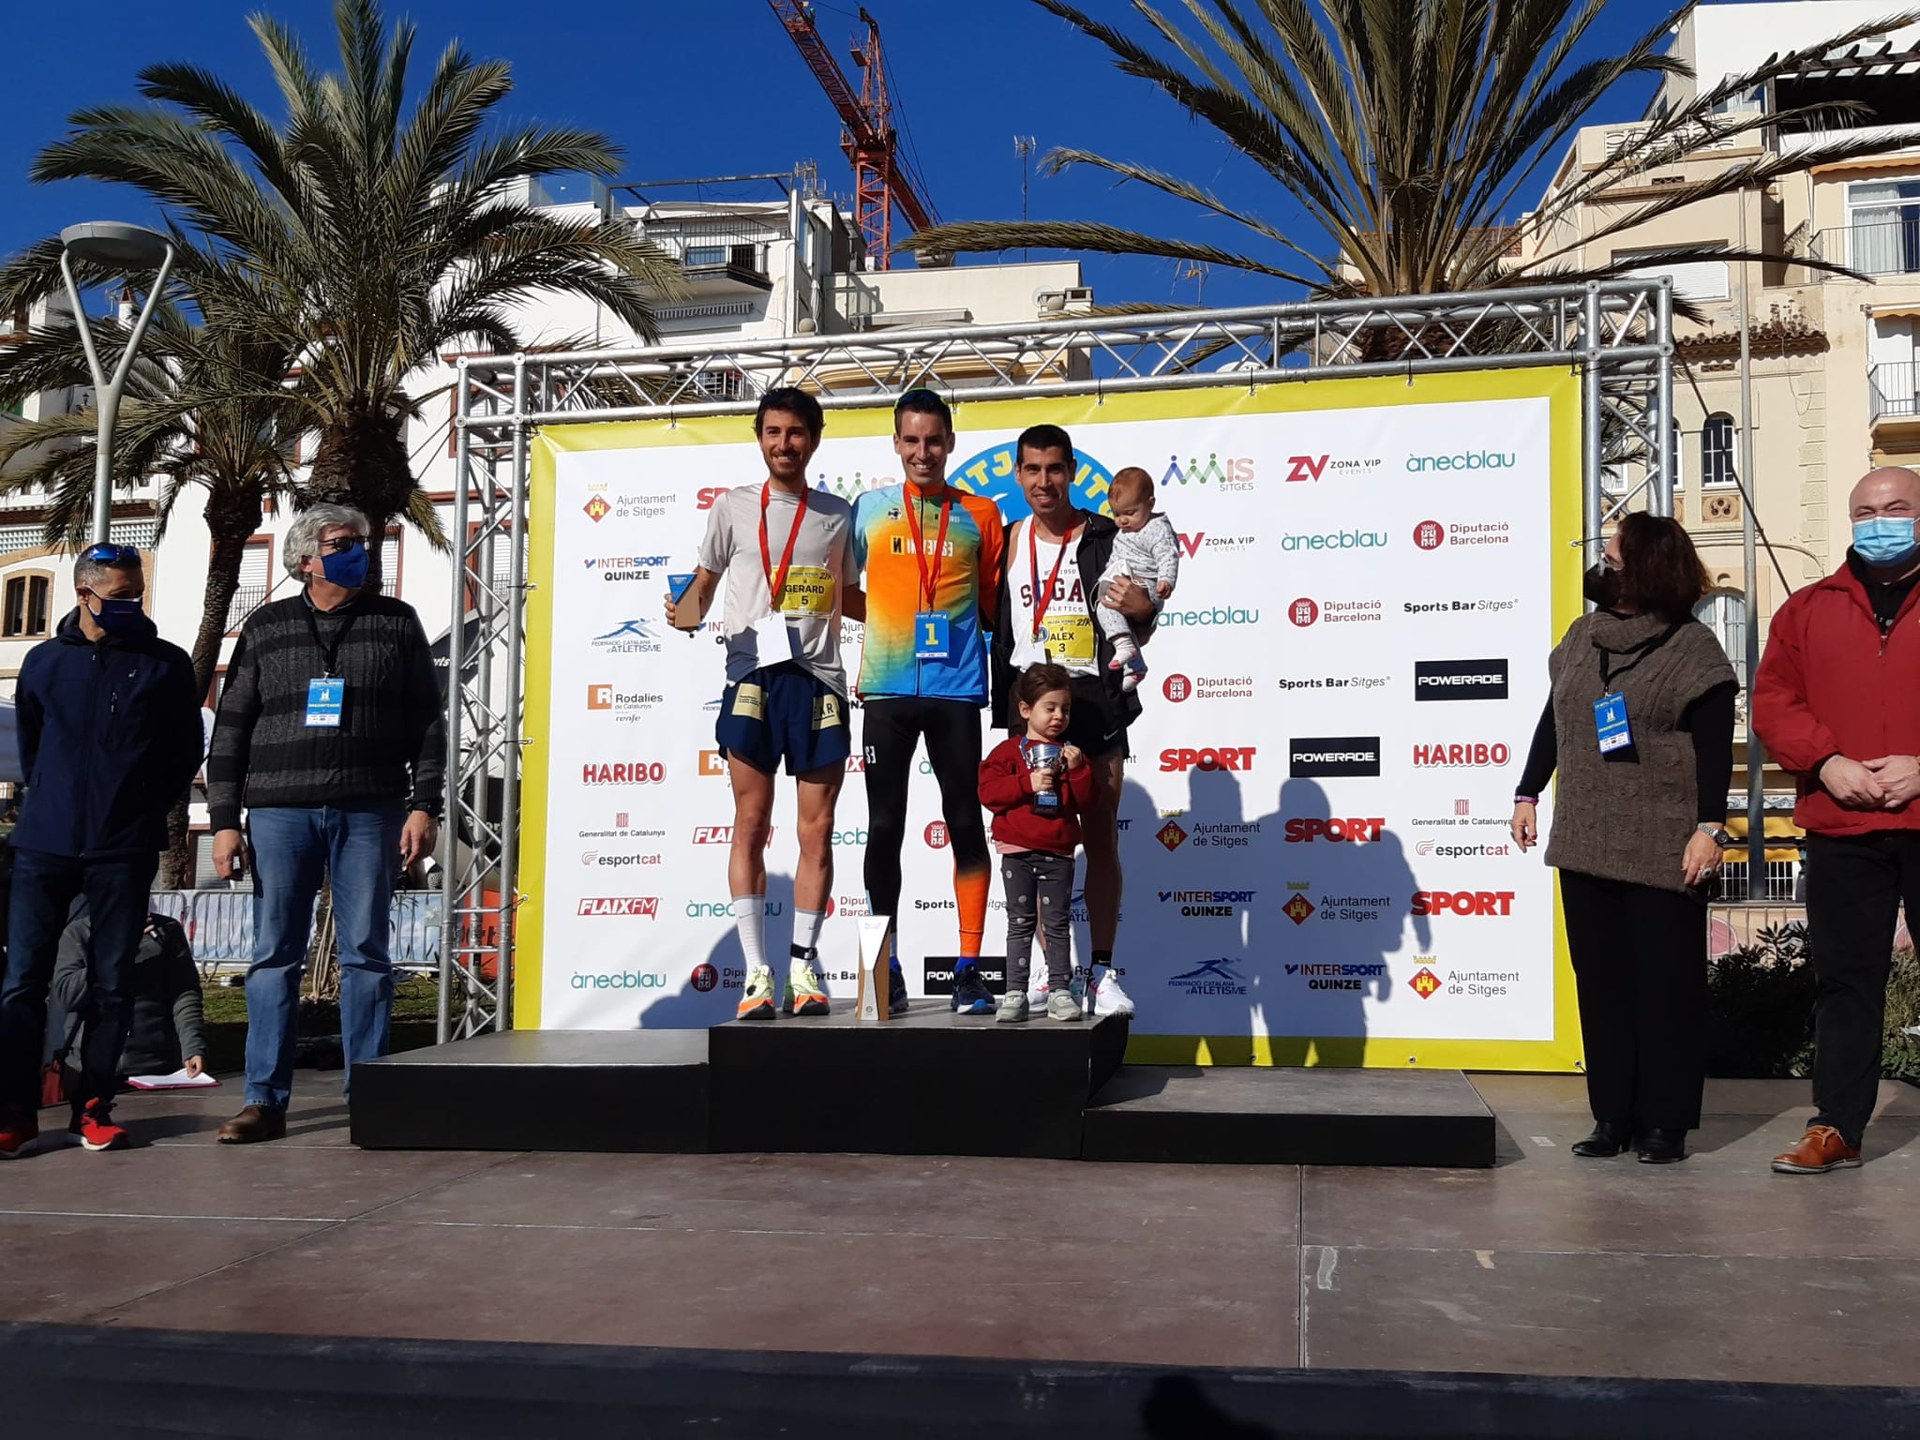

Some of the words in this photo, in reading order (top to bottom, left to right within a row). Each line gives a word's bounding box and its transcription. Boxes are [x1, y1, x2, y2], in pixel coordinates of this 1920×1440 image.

[1330, 460, 1360, 469] ZONA
[1364, 459, 1381, 467] VIP
[1406, 450, 1515, 472] ànecblau
[1219, 483, 1254, 492] SITGES
[616, 493, 676, 506] Ajuntament
[616, 507, 629, 518] de
[631, 506, 665, 518] Sitges
[1450, 522, 1509, 536] Diputació
[1205, 538, 1234, 546] ZONA
[1238, 537, 1255, 545] VIP
[1282, 530, 1387, 551] ànecblau
[1450, 533, 1509, 545] Barcelona
[598, 556, 671, 569] INTERSPORT
[604, 571, 650, 581] QUINZE
[785, 584, 825, 594] GERARD
[801, 595, 809, 605] 5
[1324, 600, 1381, 613] Diputació
[1404, 602, 1448, 614] Sports
[1451, 600, 1476, 611] Bar
[1324, 611, 1381, 623] Barcelona
[925, 623, 938, 645] 1
[1050, 632, 1075, 641] ALEX
[1058, 643, 1066, 653] 3
[1197, 676, 1253, 689] Diputació
[1279, 678, 1322, 690] Sports
[1326, 677, 1349, 688] Bar
[1418, 674, 1504, 686] POWERADE
[615, 693, 663, 703] Rodalies
[1197, 687, 1253, 699] Barcelona
[615, 714, 641, 724] renfe
[1159, 747, 1257, 772] SPORT
[1292, 751, 1377, 763] POWERADE
[1412, 743, 1510, 766] HARIBO
[582, 762, 665, 784] HARIBO
[1411, 818, 1456, 826] Generalitat
[1458, 818, 1469, 826] de
[1471, 818, 1512, 827] Catalunya
[579, 830, 618, 838] Generalitat
[620, 829, 628, 837] de
[630, 829, 665, 838] Catalunya
[1193, 823, 1260, 836] Ajuntament
[1284, 818, 1385, 843] SPORT
[1193, 835, 1206, 846] de
[1209, 834, 1248, 848] Sitges
[1435, 842, 1509, 859] esportcat
[598, 853, 661, 868] esportcat
[1173, 891, 1256, 903] INTERSPORT
[1320, 895, 1390, 909] Ajuntament
[915, 900, 954, 910] Sports
[1410, 892, 1514, 916] SPORT
[1181, 905, 1232, 917] QUINZE
[1320, 909, 1335, 920] de
[1338, 908, 1378, 922] Sitges
[1300, 963, 1387, 977] INTERSPORT
[571, 970, 666, 989] ànecblau
[1448, 970, 1520, 985] Ajuntament
[1308, 979, 1362, 990] QUINZE
[1448, 984, 1464, 996] de
[1467, 983, 1507, 997] Sitges
